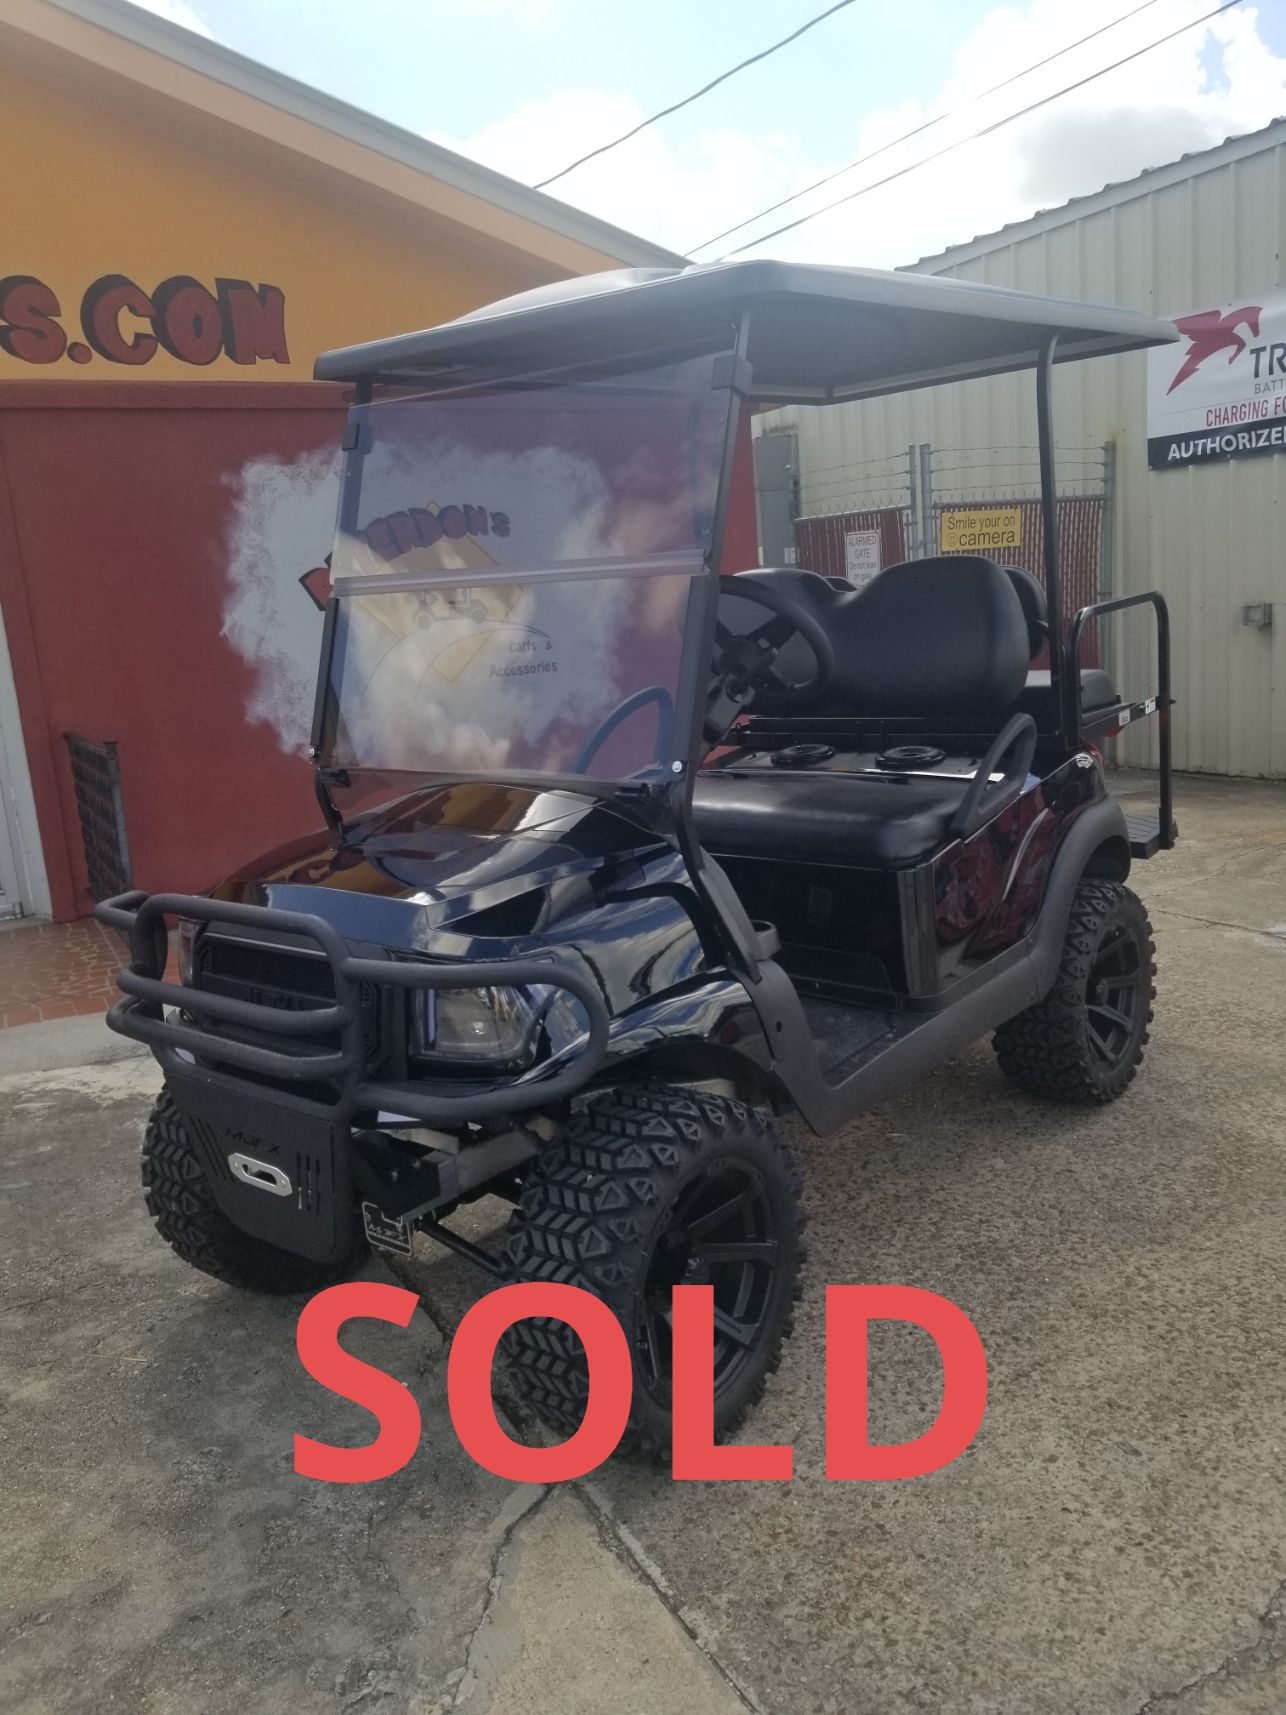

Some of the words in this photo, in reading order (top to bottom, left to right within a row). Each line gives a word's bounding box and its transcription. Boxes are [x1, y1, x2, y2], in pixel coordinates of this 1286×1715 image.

[1206, 399, 1269, 427] CHARGING
[947, 515, 977, 531] Smile
[979, 516, 1001, 532] your
[1003, 516, 1016, 527] on
[959, 529, 1016, 547] camera
[854, 548, 871, 559] GATE
[489, 660, 559, 679] Accessories
